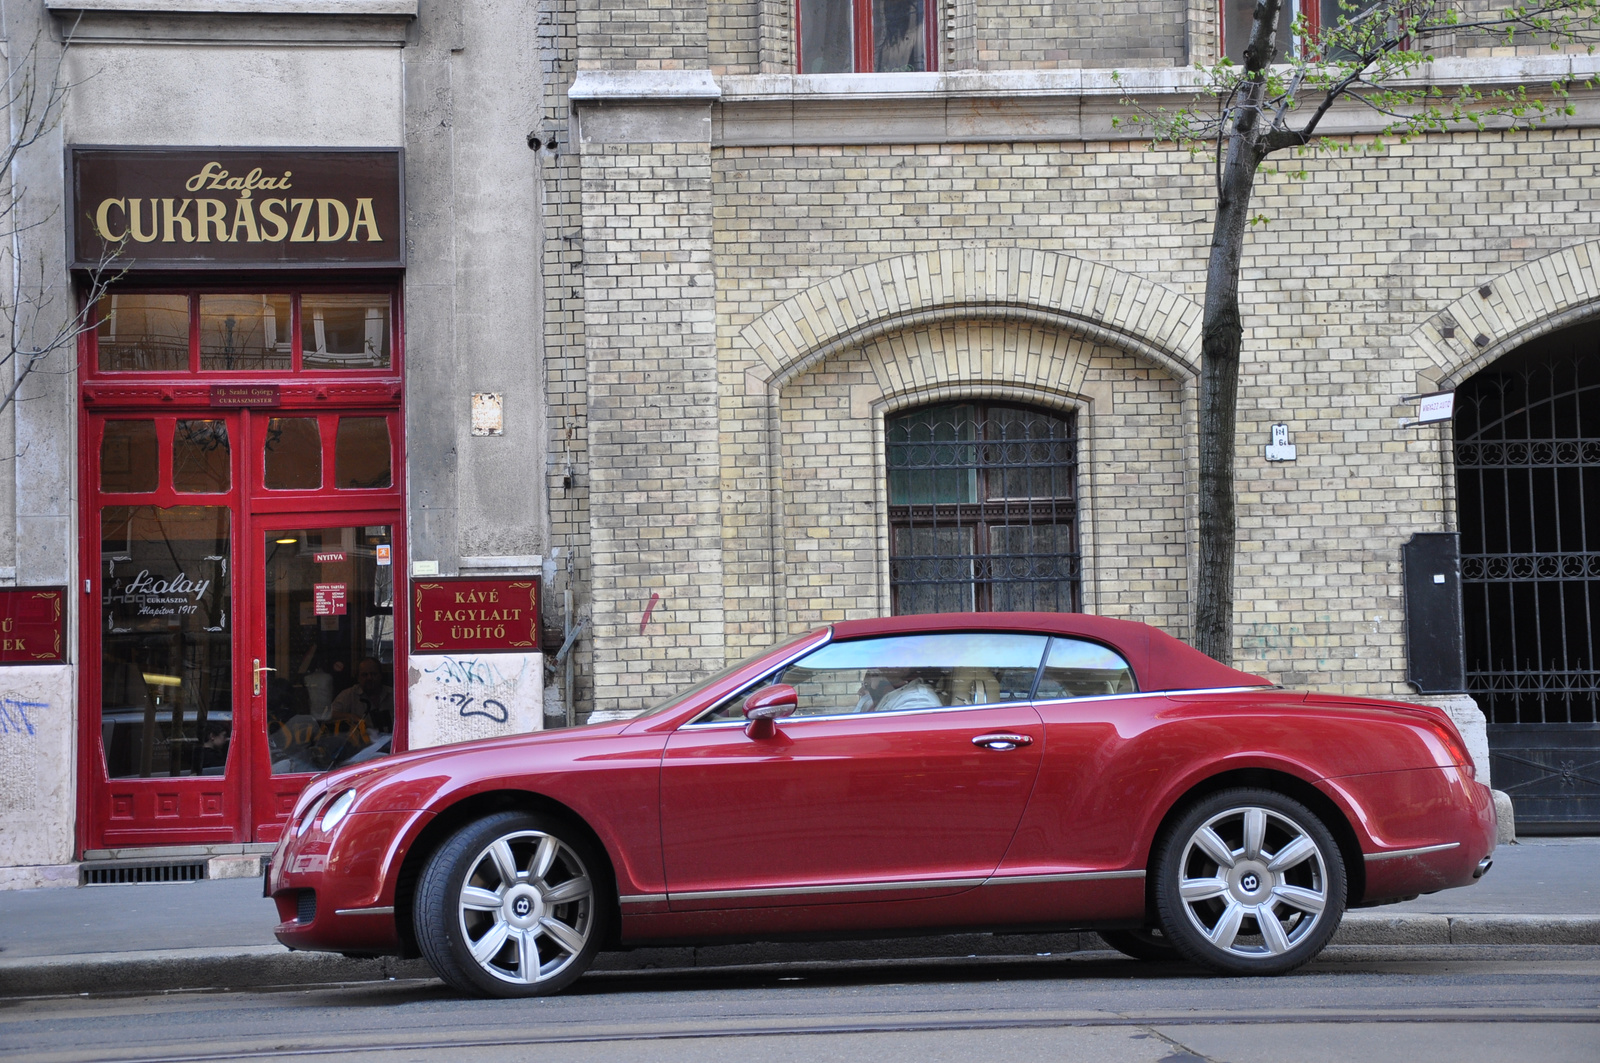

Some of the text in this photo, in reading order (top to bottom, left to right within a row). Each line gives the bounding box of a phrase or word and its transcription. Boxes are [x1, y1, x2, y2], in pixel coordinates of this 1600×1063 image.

[186, 161, 292, 192] Szalai
[96, 188, 384, 243] CUKRÁSZDA
[317, 553, 343, 561] NYITVA
[455, 589, 499, 603] KÁVÉ
[177, 605, 198, 615] 1917
[434, 608, 521, 621] FAGYLALT
[451, 624, 506, 639] ÜDÍTŐ
